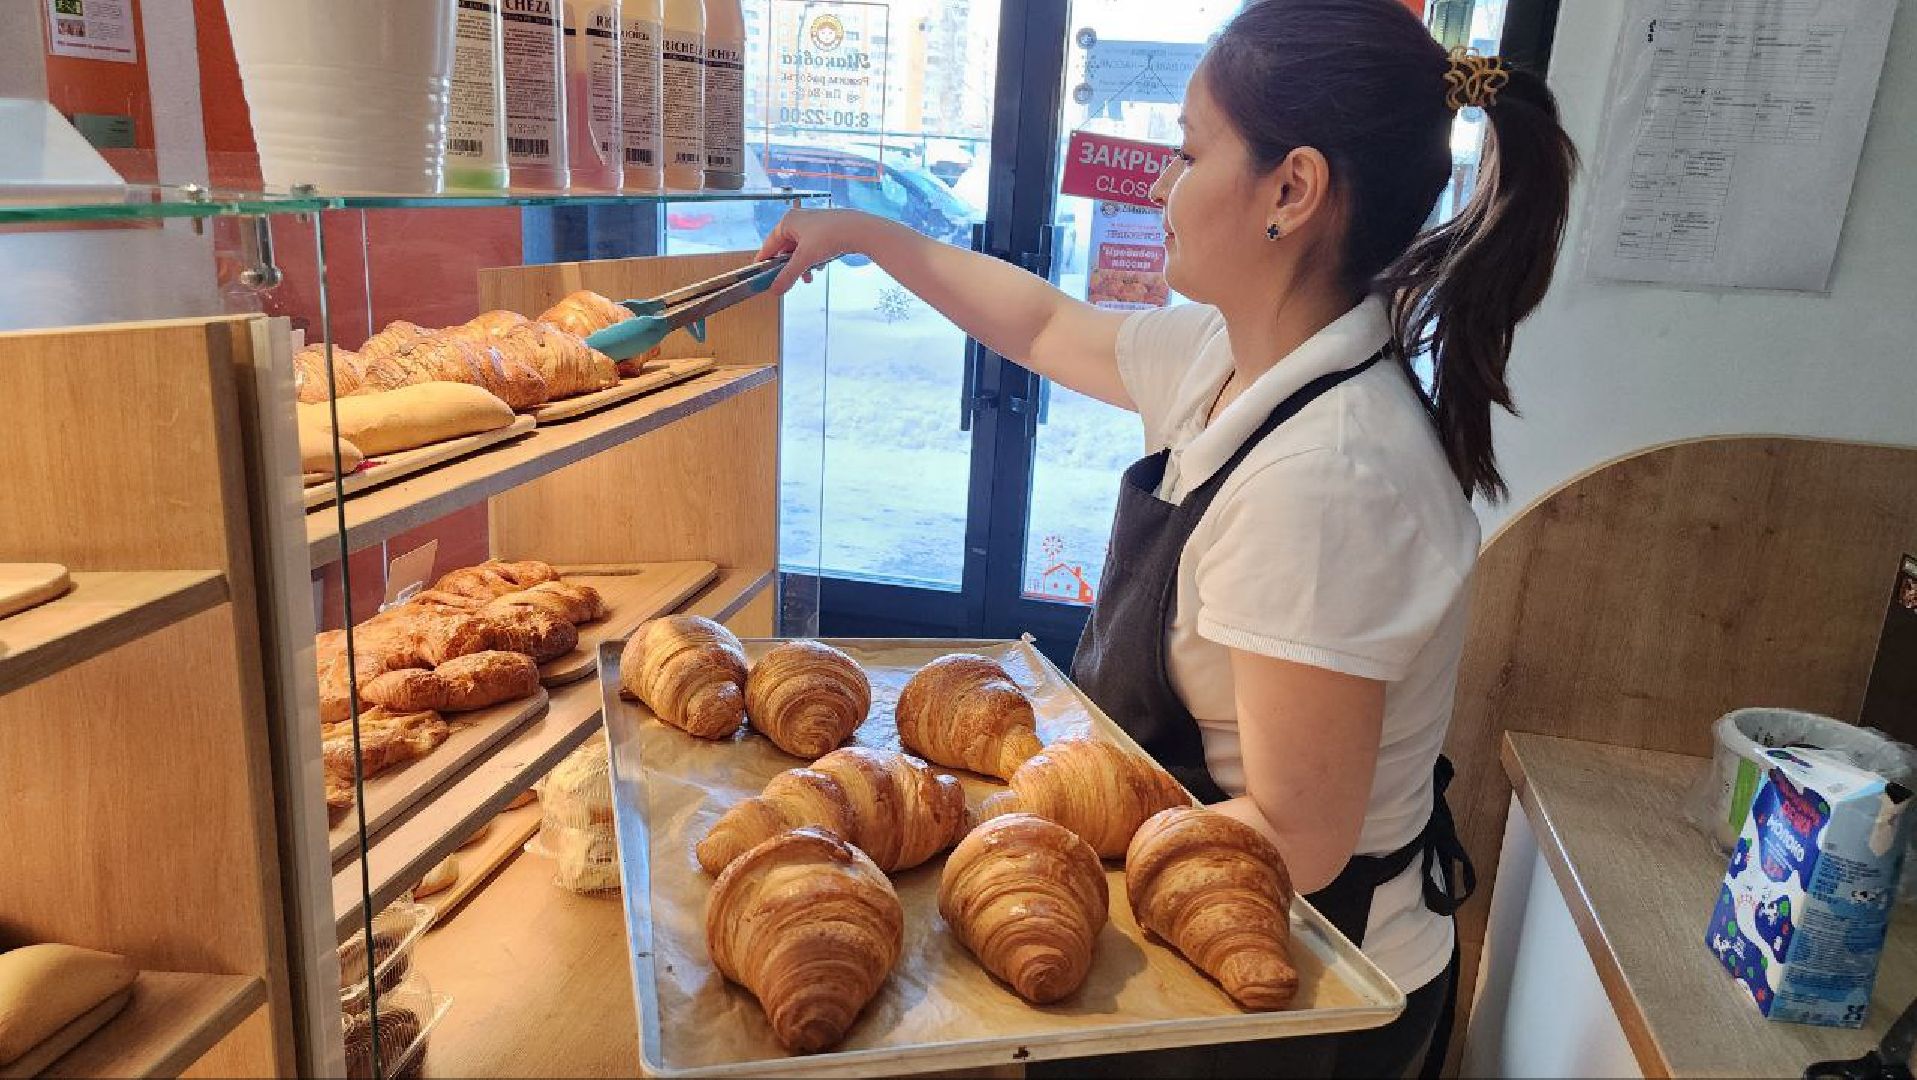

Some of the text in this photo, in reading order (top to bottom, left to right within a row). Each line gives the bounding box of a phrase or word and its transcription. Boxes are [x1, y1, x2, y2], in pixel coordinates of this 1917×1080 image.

[504, 0, 552, 13] CHEZA
[1079, 141, 1171, 174] ЗАКРЫ
[1096, 175, 1149, 198] CLOS
